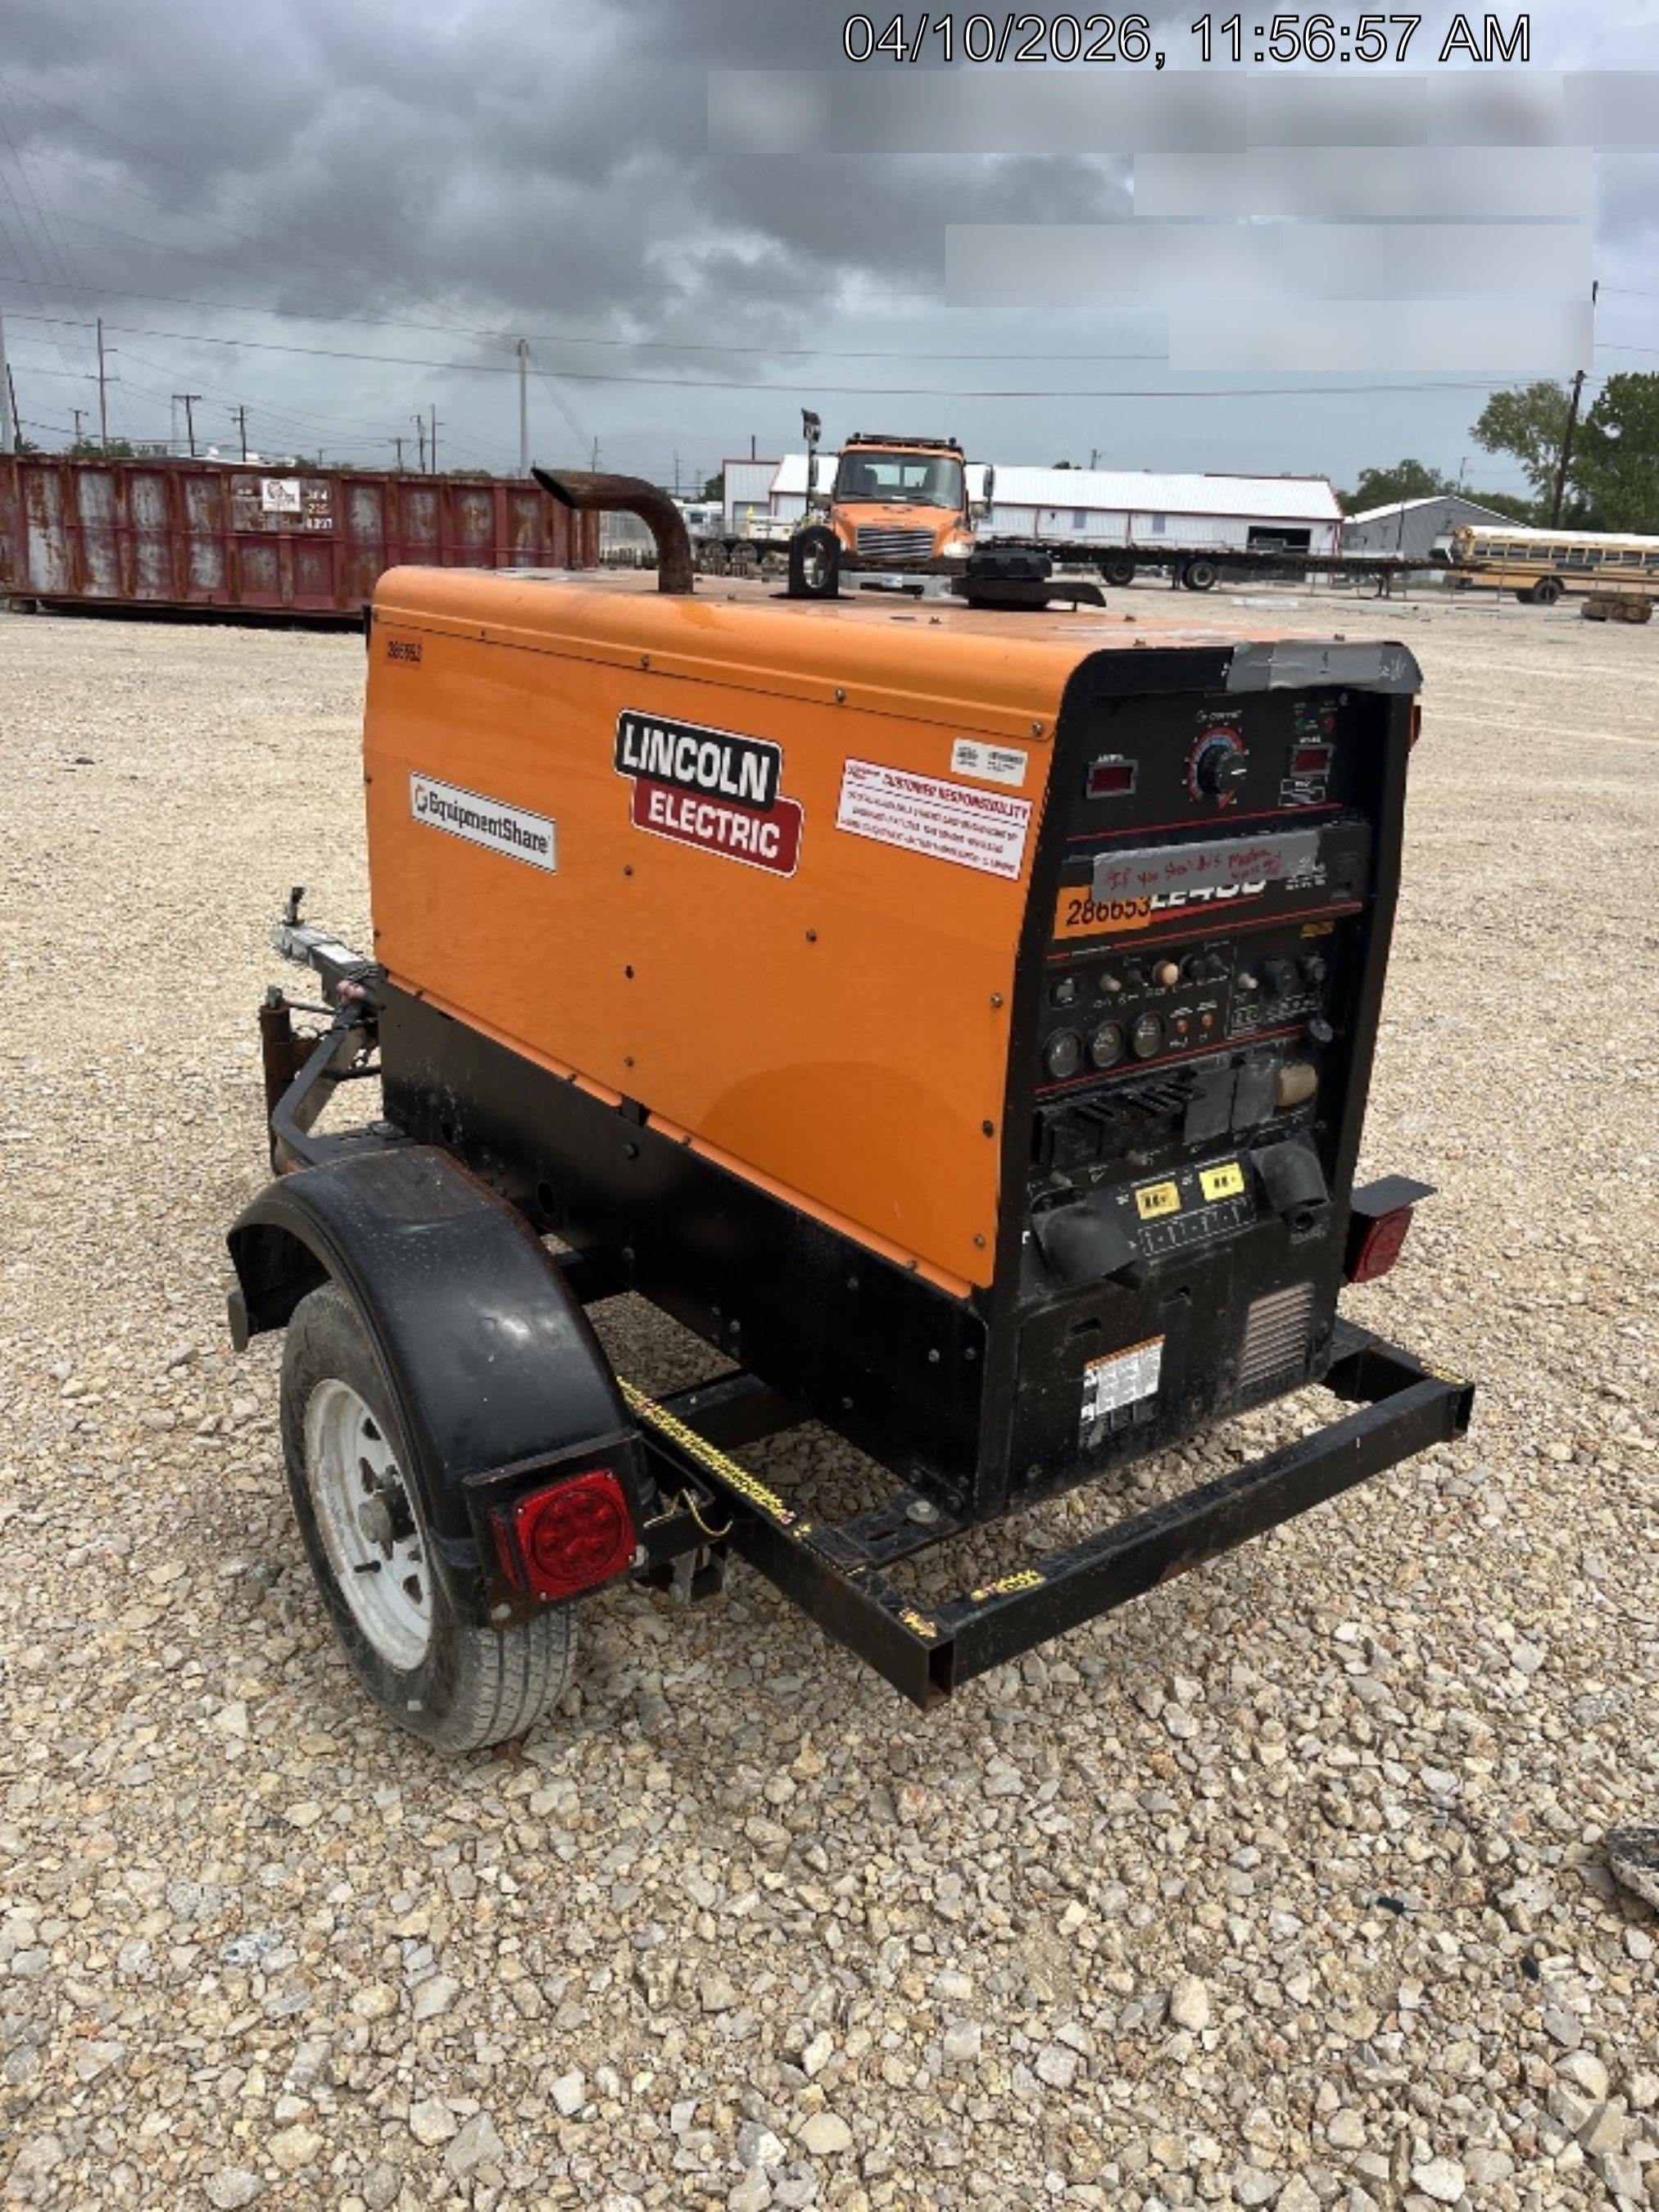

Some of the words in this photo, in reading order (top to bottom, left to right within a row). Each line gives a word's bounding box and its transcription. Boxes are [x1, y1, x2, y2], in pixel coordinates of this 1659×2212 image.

[623, 721, 771, 802] LINCOLN
[428, 791, 550, 855] EquipmentShare
[648, 790, 781, 859] ELECTRIC
[882, 773, 937, 798] CUSTOMER
[938, 786, 1029, 820] RESPONSIBILITY
[1067, 895, 1151, 926] 286653
